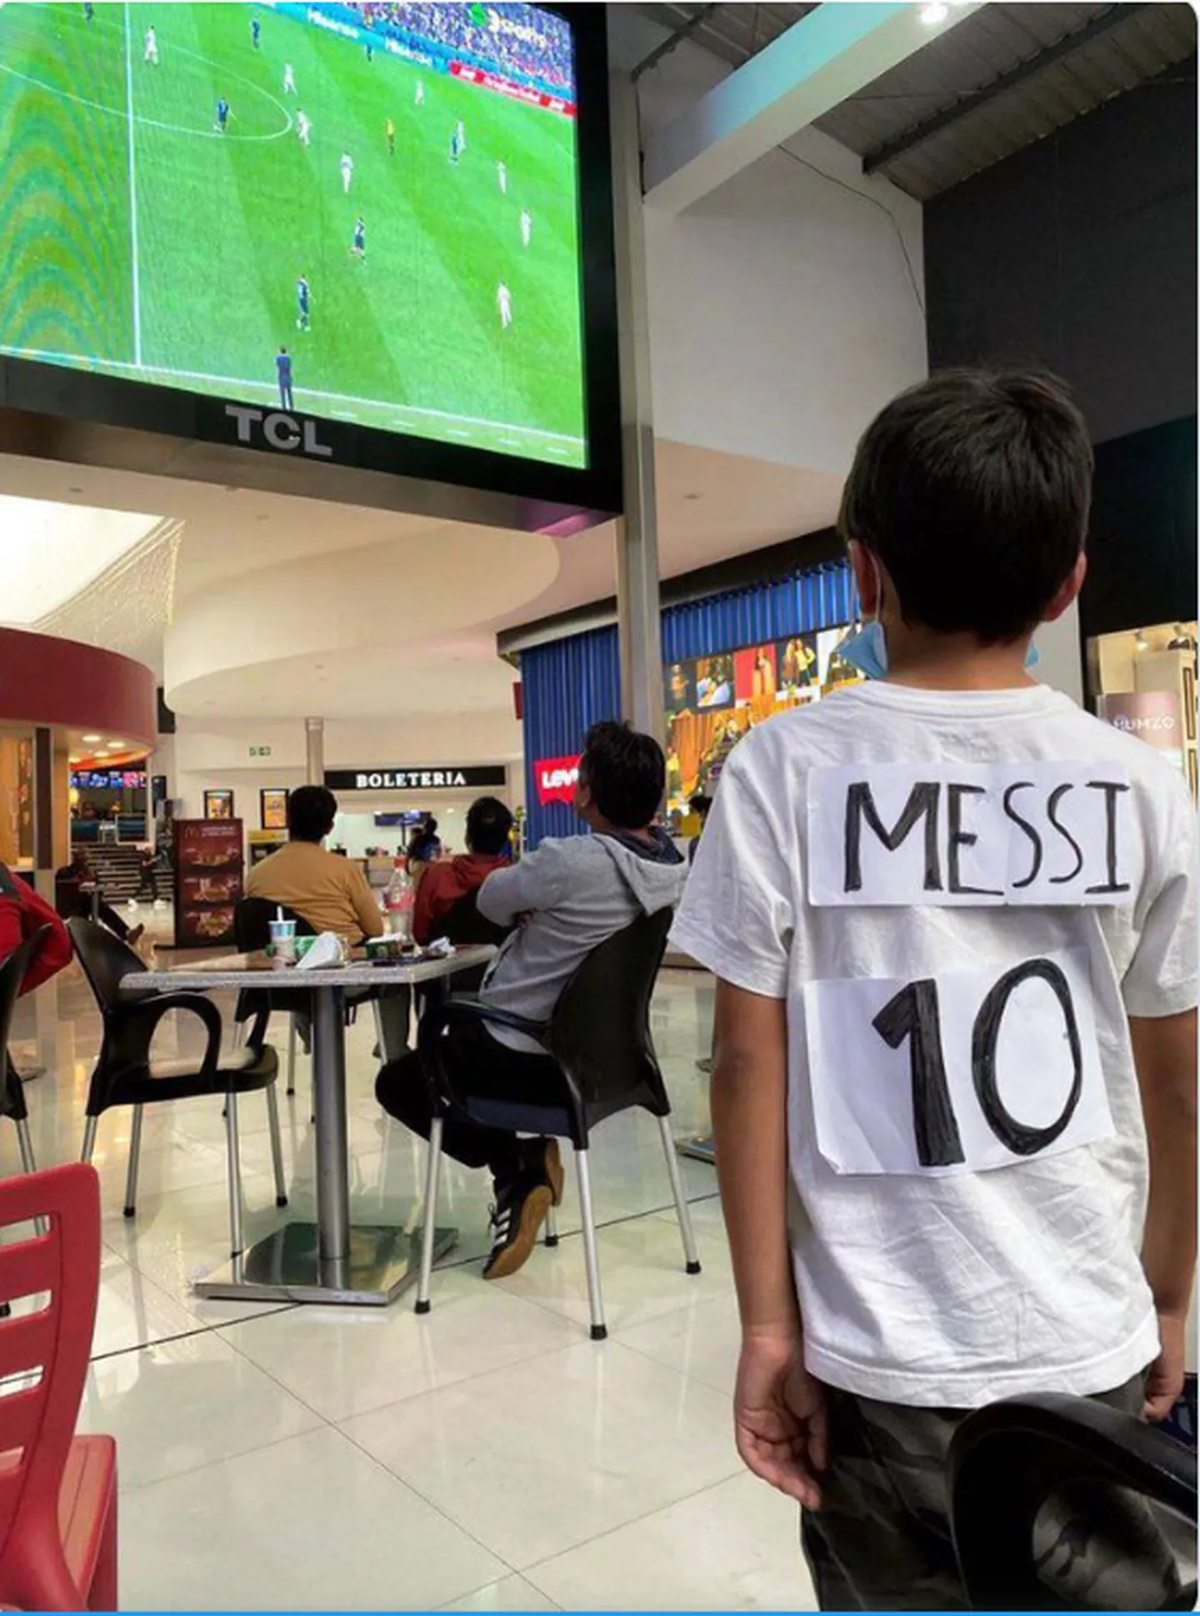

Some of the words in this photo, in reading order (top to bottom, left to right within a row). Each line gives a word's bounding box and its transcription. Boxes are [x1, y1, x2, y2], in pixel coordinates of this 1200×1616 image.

[225, 404, 332, 456] TCL
[356, 771, 466, 788] BOLETERIA
[844, 782, 1130, 895] MESSI
[871, 958, 1083, 1167] 10
